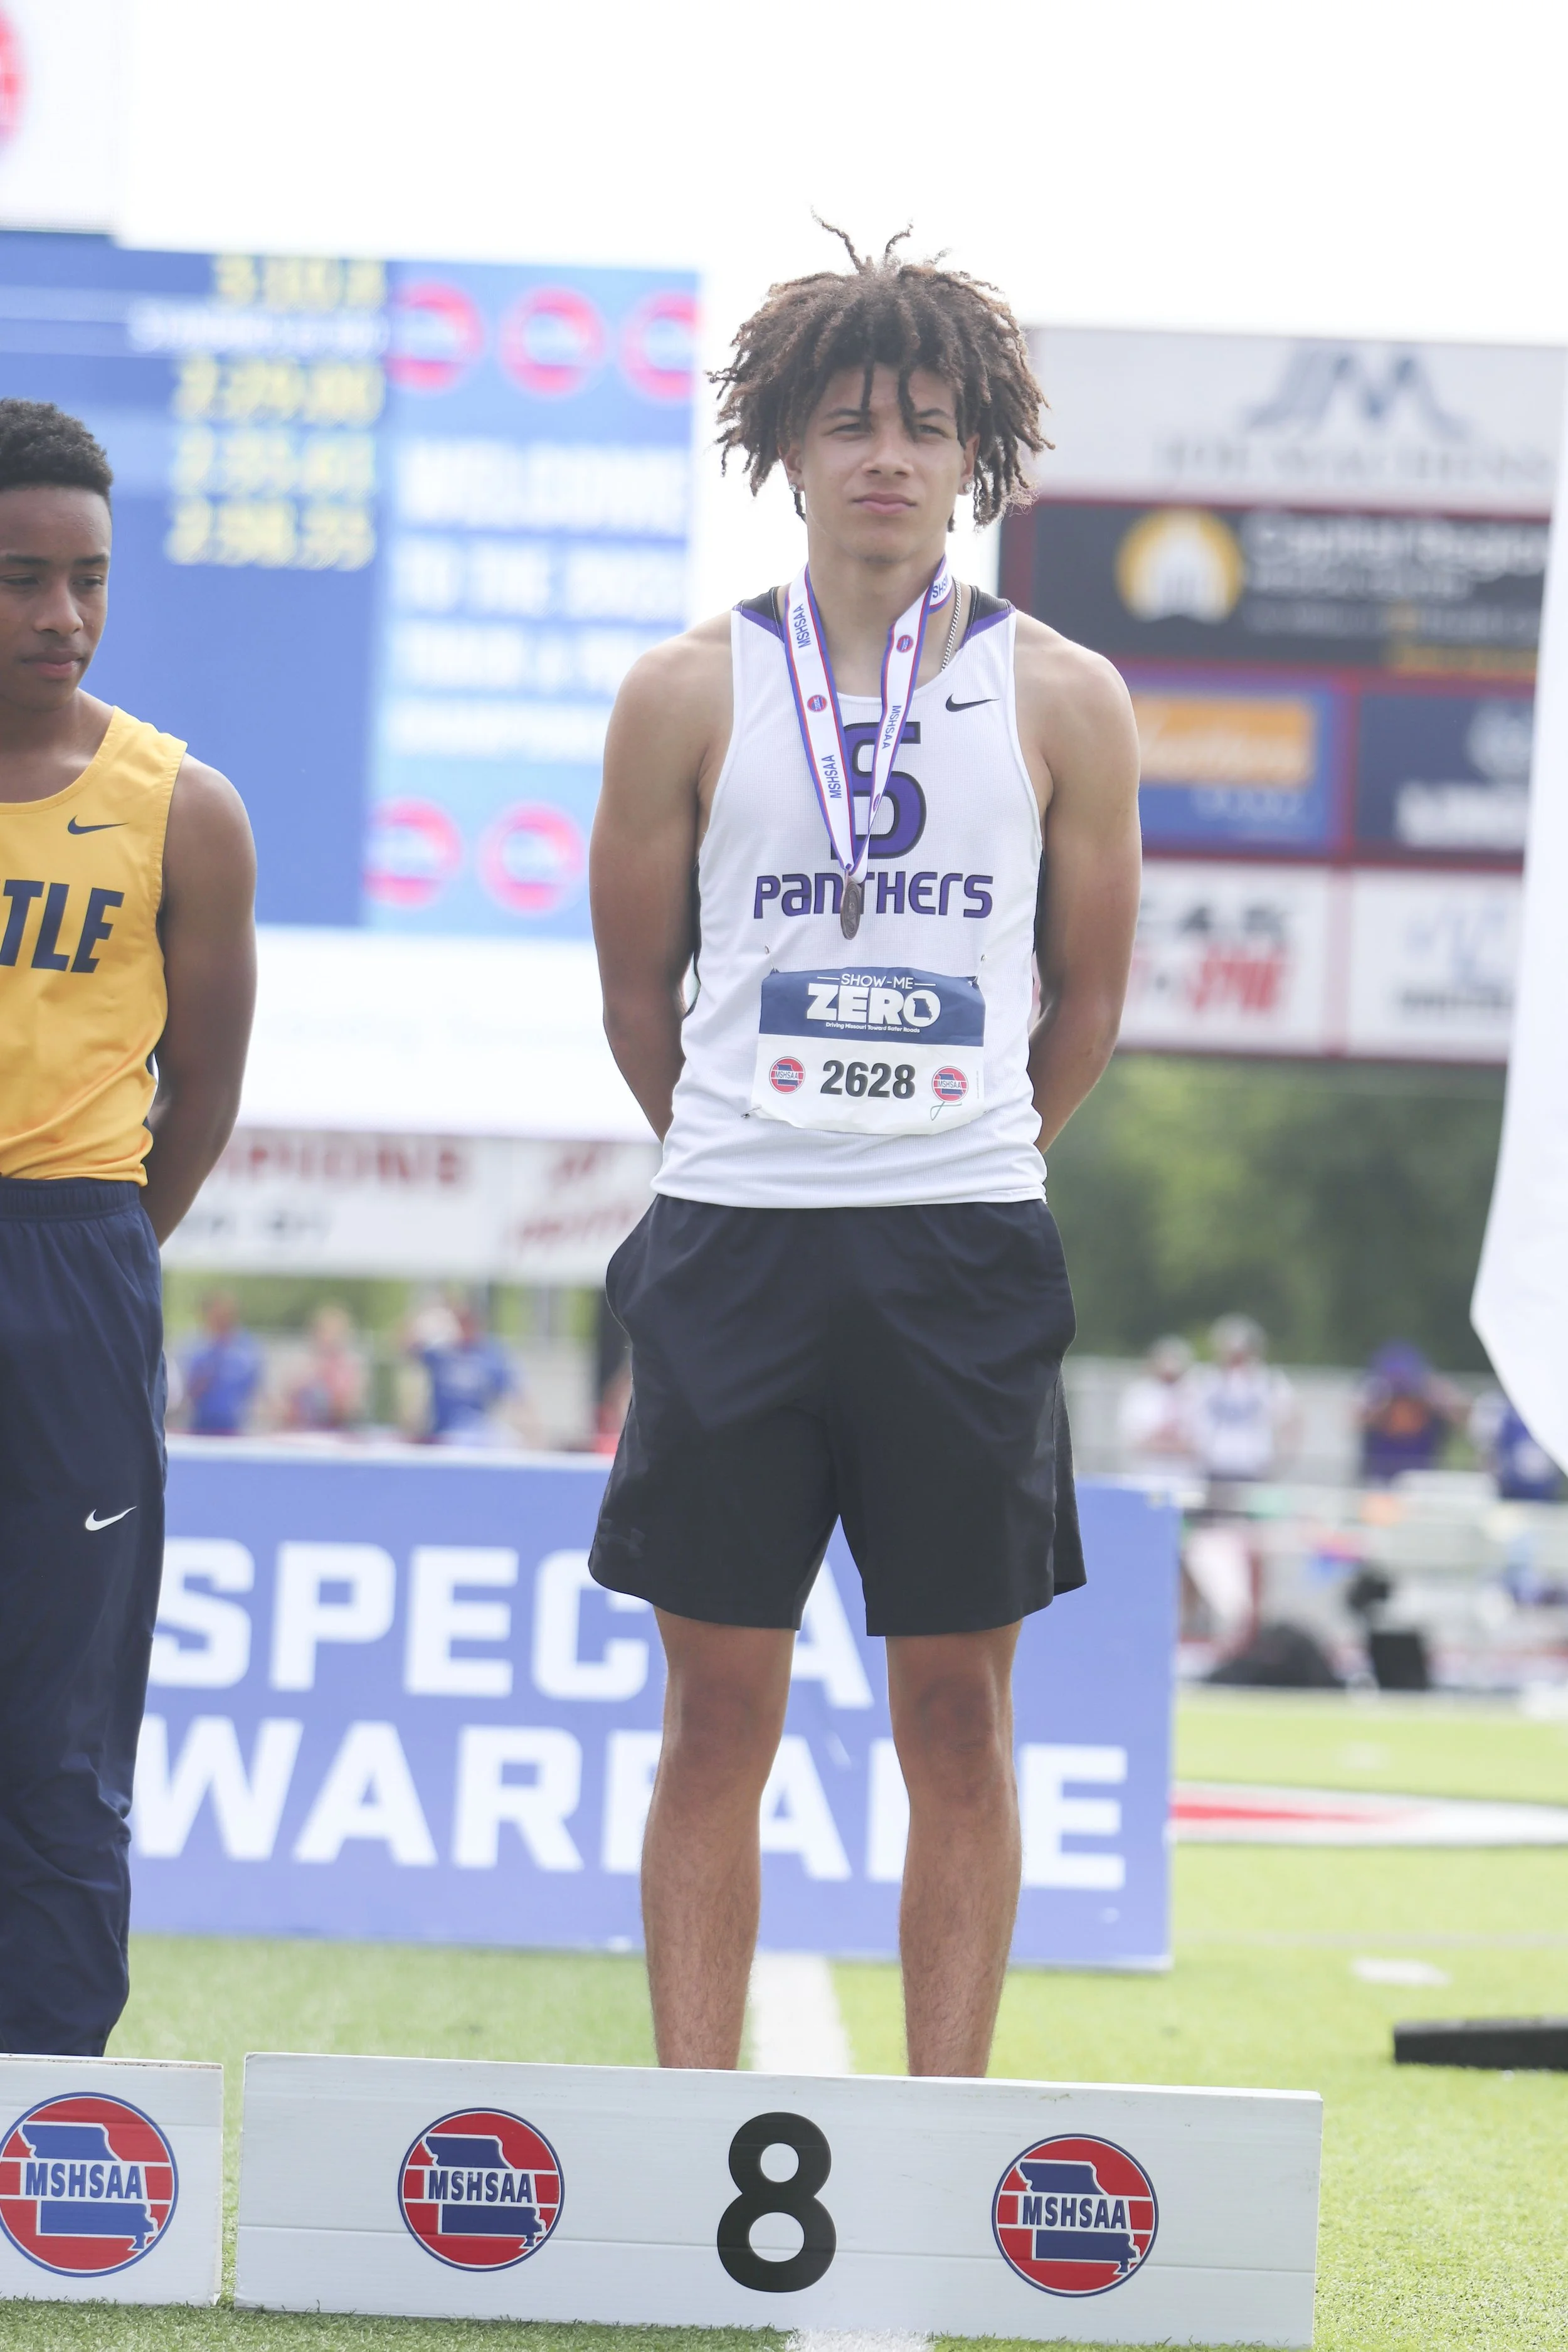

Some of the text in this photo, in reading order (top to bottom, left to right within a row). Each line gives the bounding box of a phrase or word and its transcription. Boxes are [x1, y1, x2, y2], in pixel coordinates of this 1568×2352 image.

[794, 603, 812, 649] MSHSAA
[882, 704, 902, 750] MSHSAA
[822, 755, 842, 798] MSHSAA
[841, 973, 914, 990] SHOW-ME
[807, 983, 941, 1028] ZERO
[775, 1070, 799, 1081] MSHSAA
[820, 1059, 916, 1100] 2628
[938, 1080, 962, 1090] MSHSAA
[25, 2161, 144, 2201] MSHSAA
[427, 2168, 533, 2204] MSHSAA
[716, 2111, 837, 2293] 8
[1022, 2195, 1128, 2230] MSHSAA
